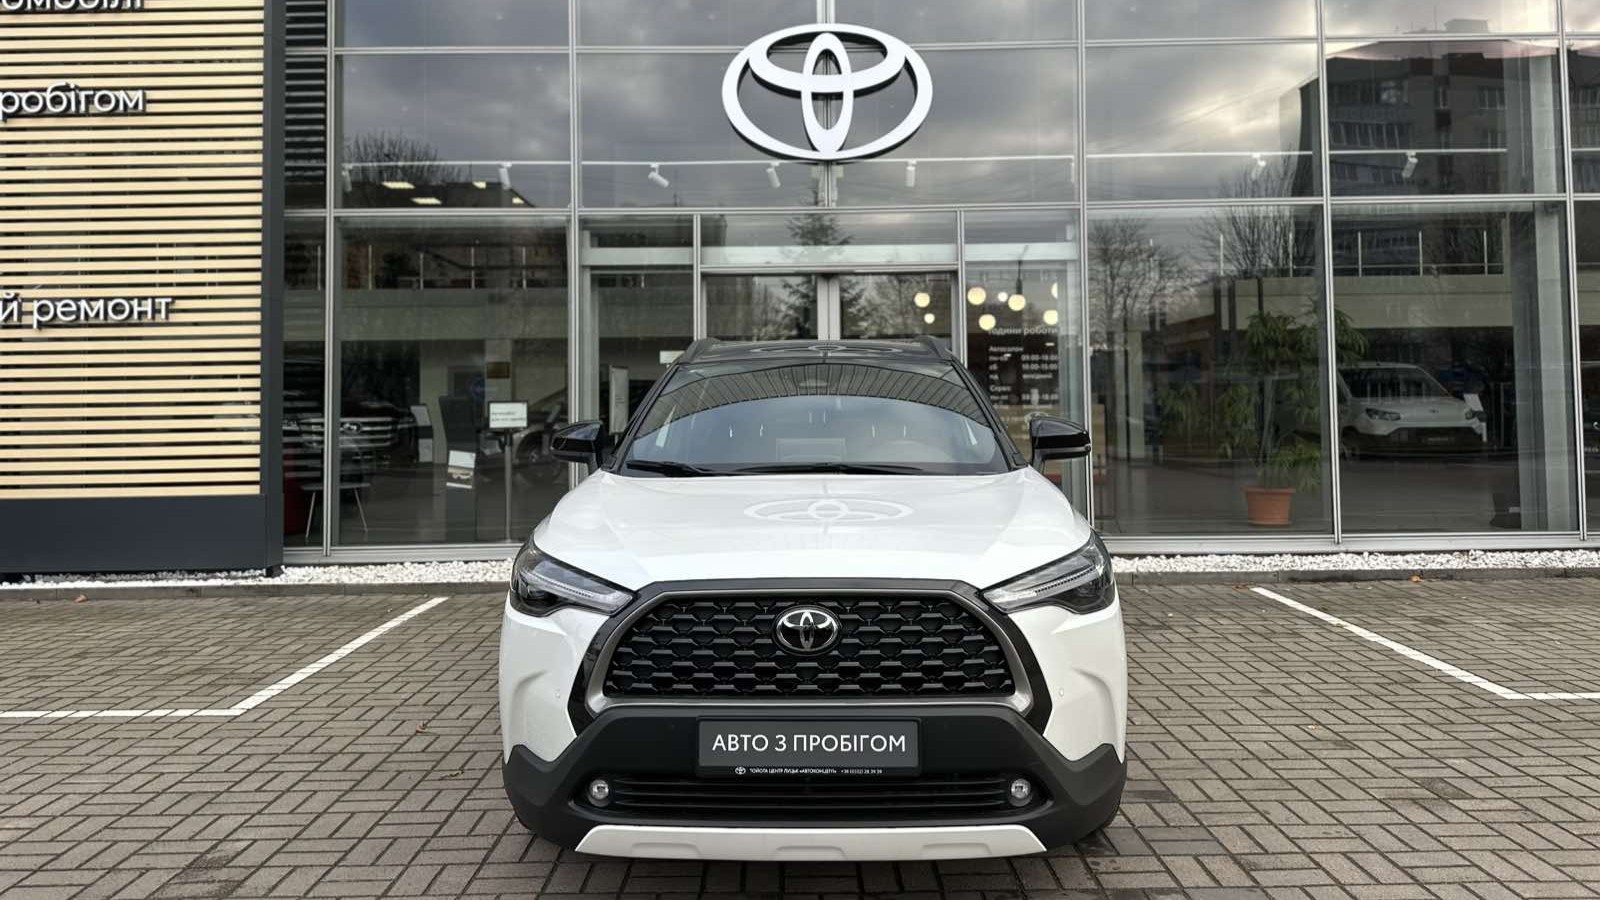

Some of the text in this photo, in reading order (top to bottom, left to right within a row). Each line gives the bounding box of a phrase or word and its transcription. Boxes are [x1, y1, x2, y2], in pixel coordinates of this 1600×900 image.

[0, 83, 144, 120] робігом
[33, 297, 172, 329] ремонт
[712, 734, 769, 752] АВТО
[793, 734, 906, 752] ПРОБІГОМ
